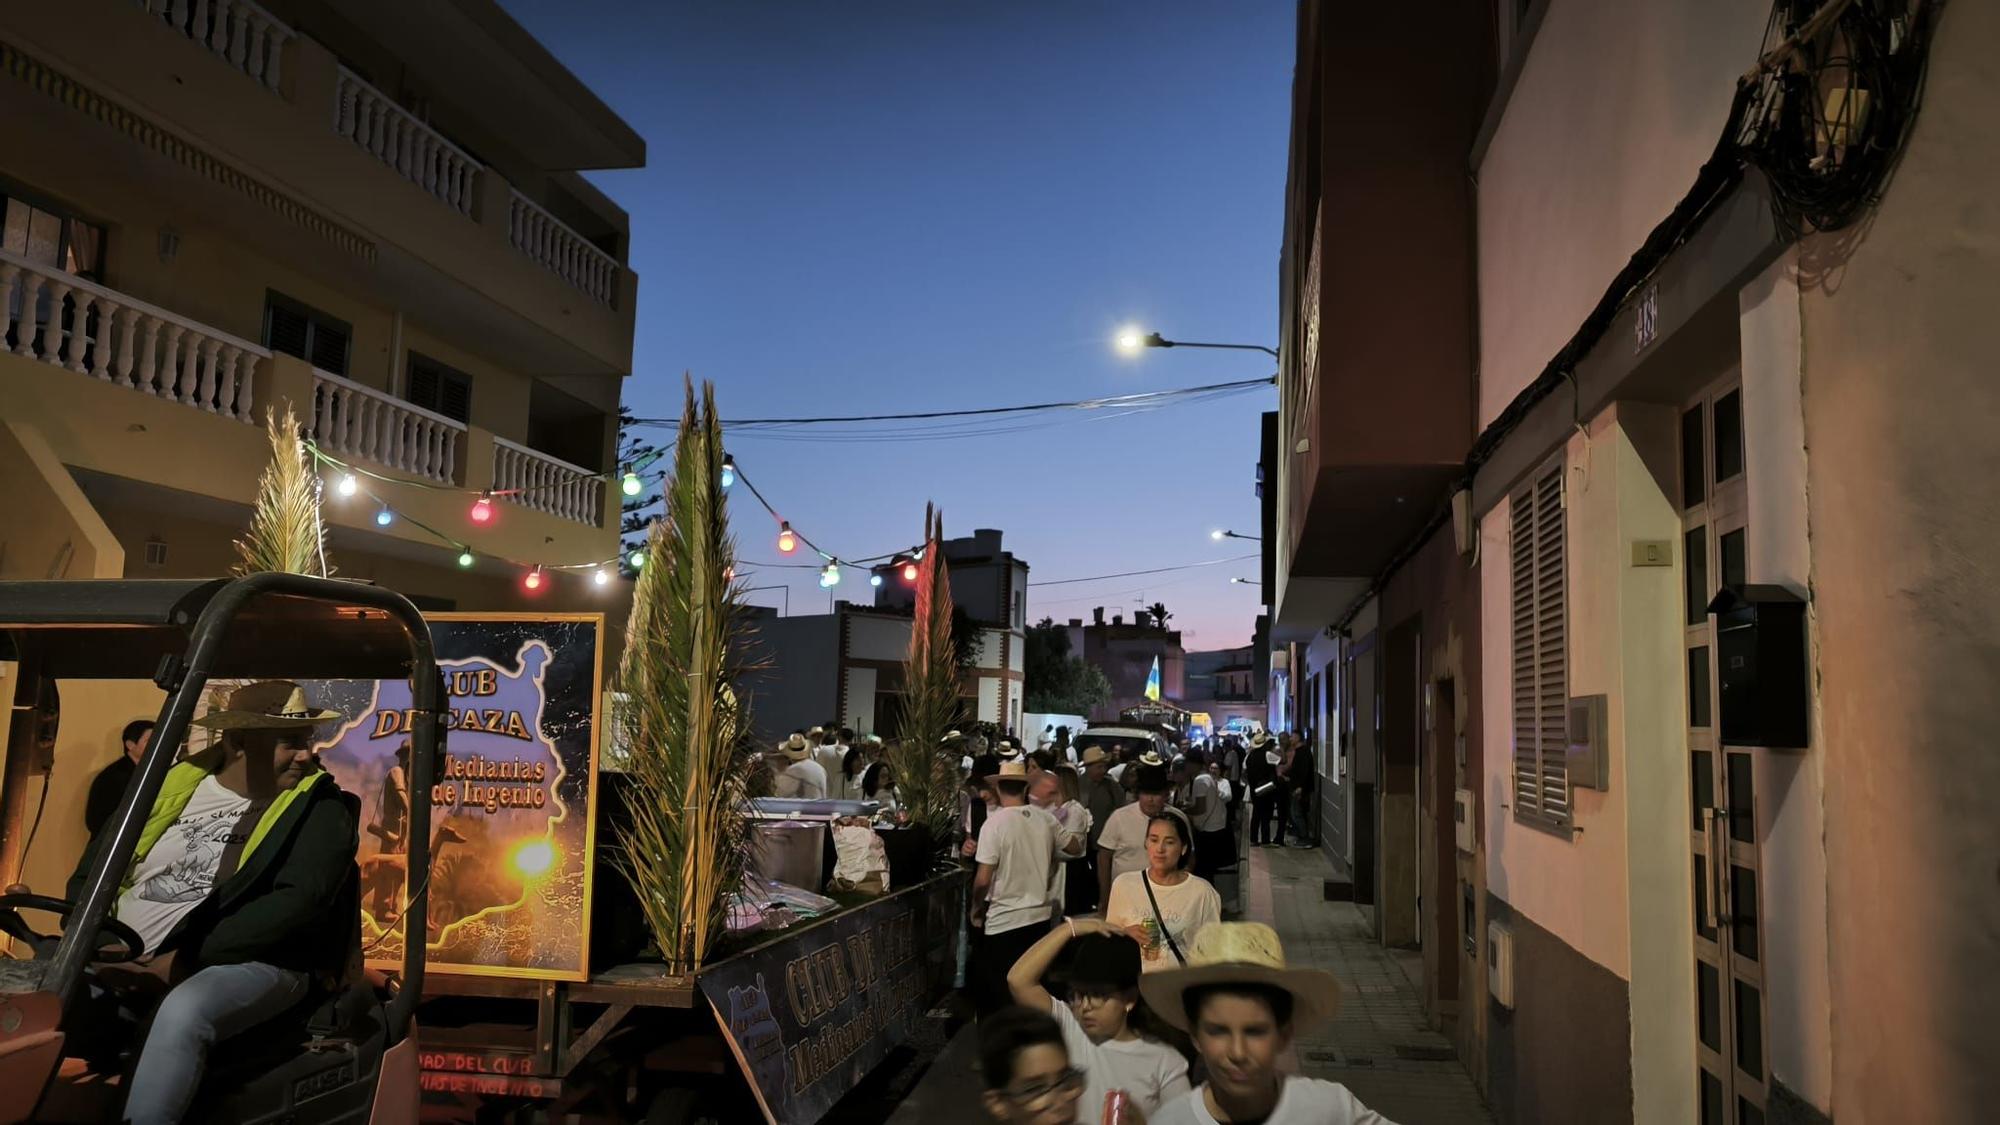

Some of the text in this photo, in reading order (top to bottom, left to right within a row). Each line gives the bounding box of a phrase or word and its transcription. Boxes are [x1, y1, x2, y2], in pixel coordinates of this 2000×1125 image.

[431, 779, 545, 814] de Ingenio
[786, 942, 850, 1028] CLUB
[455, 1056, 487, 1072] DEL
